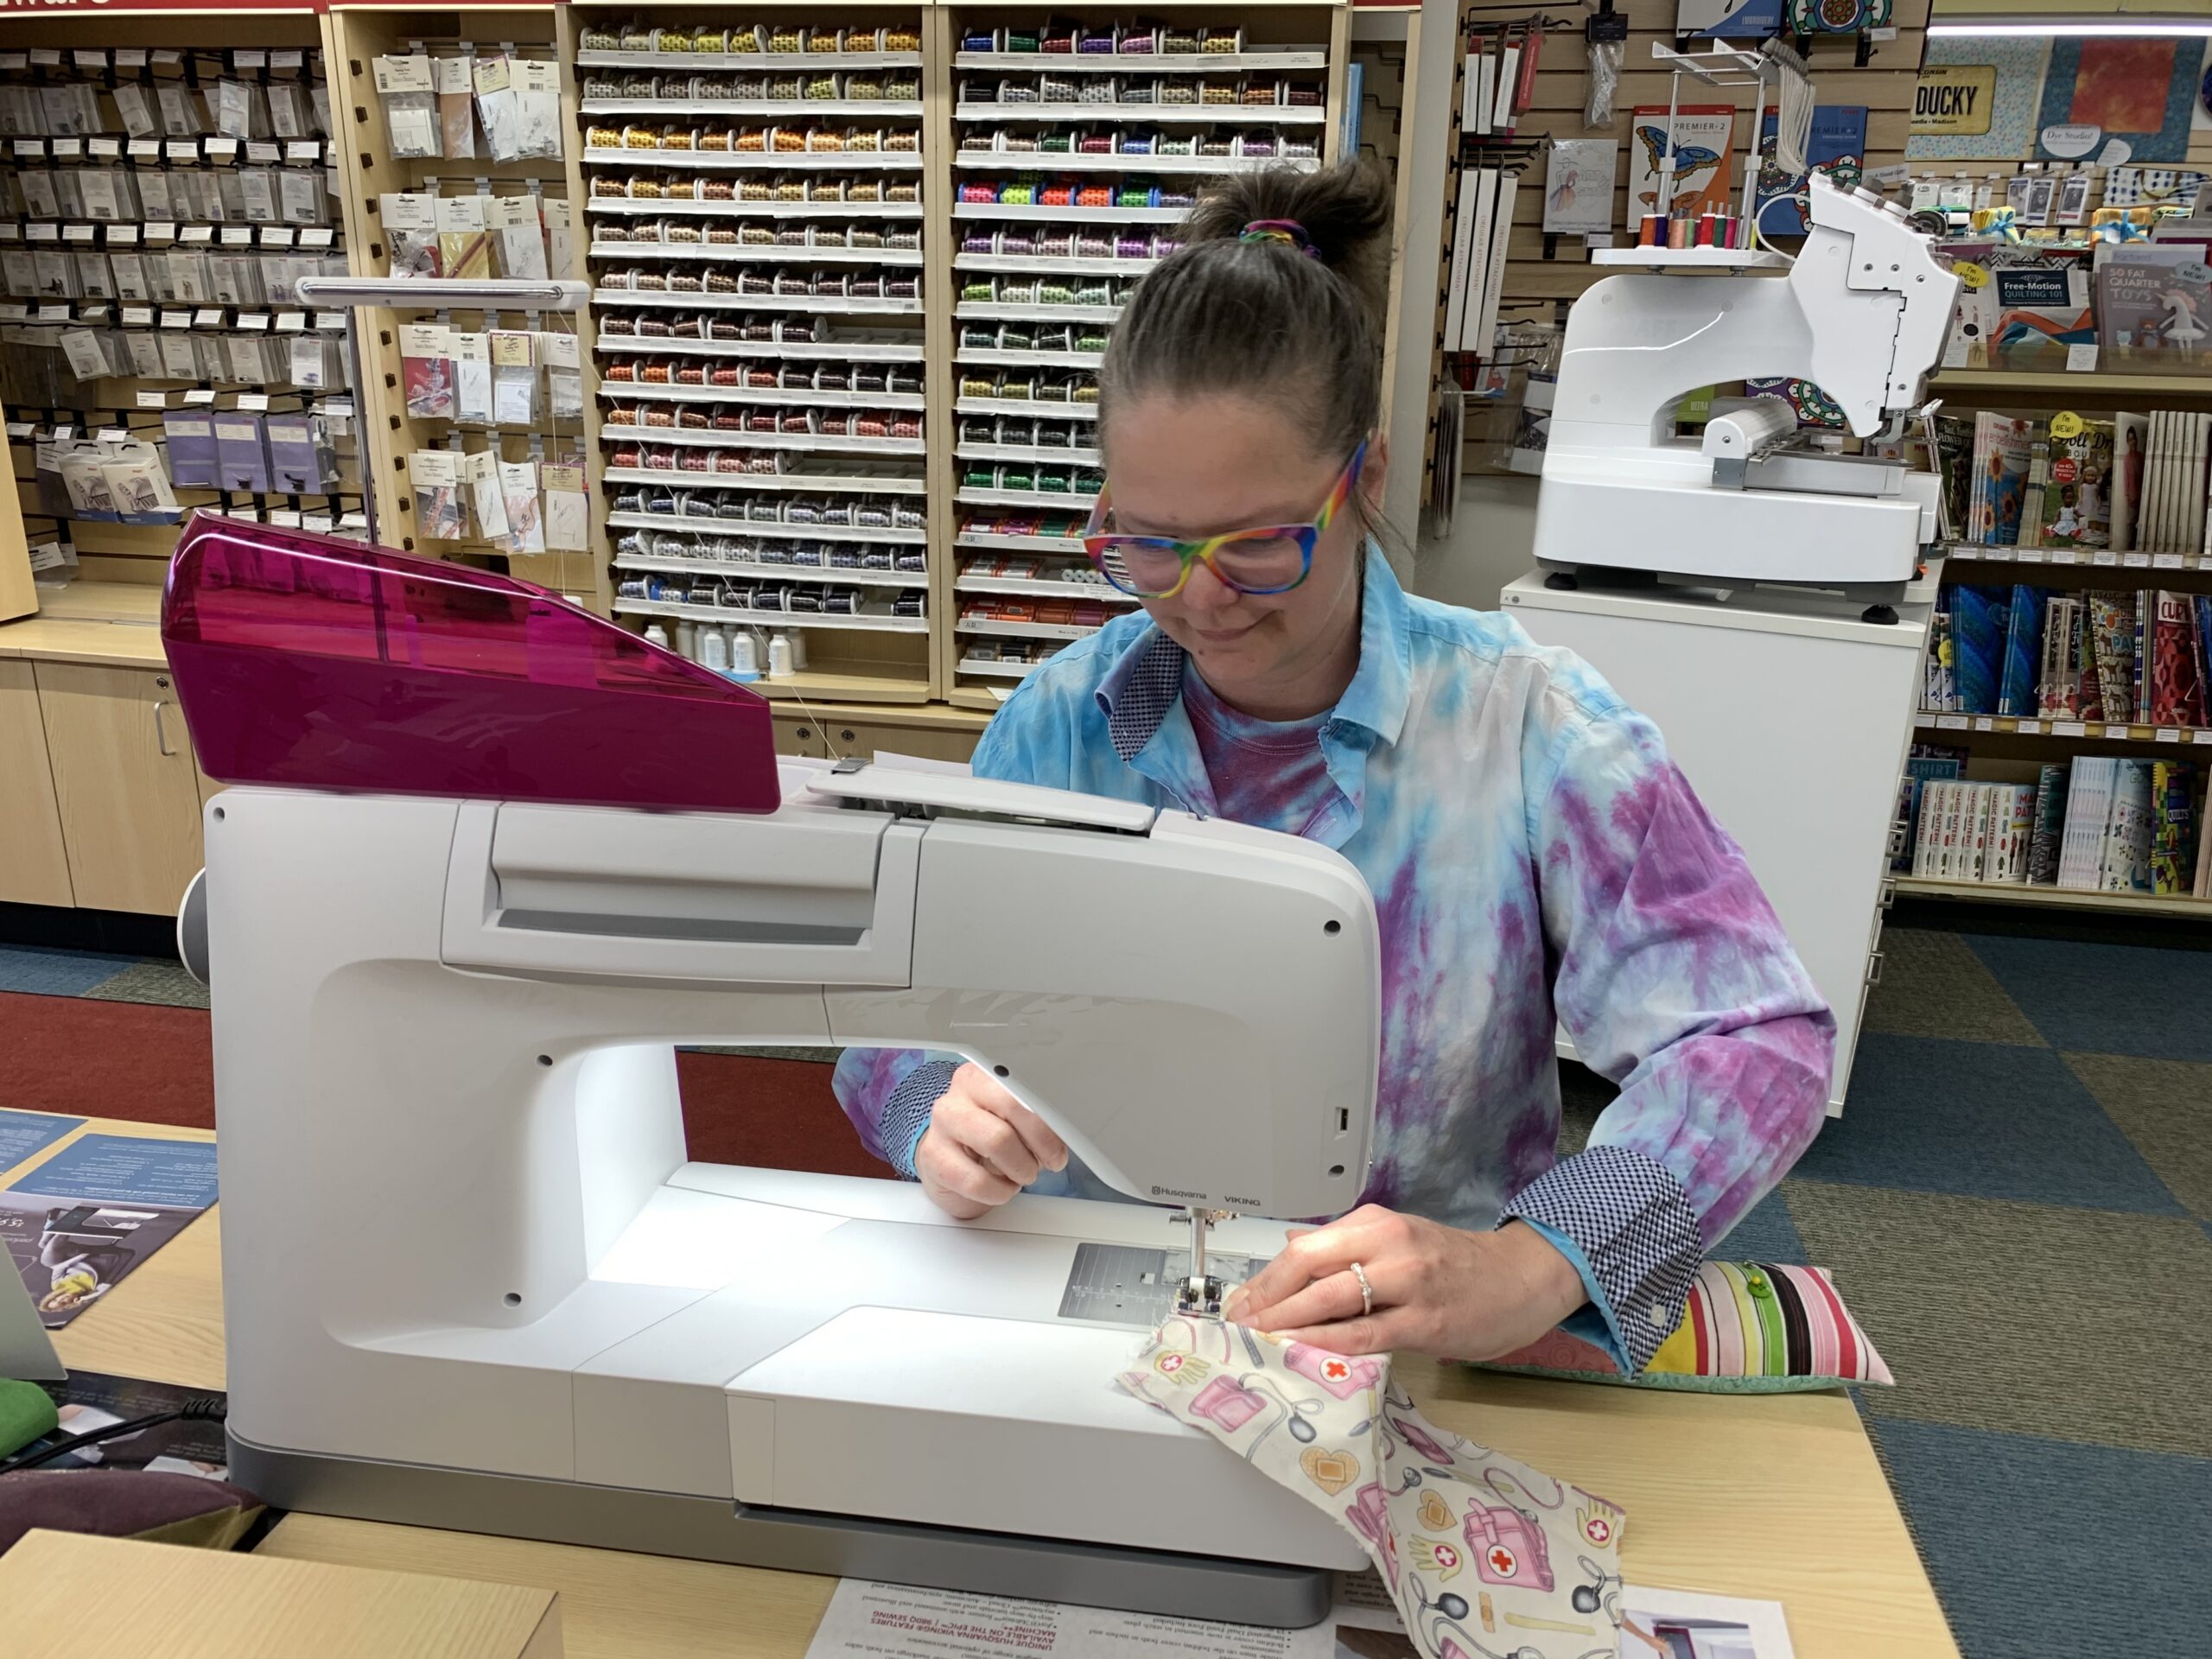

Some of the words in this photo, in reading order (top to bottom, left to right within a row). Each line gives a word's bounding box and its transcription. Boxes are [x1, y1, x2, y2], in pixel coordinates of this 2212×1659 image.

[1916, 86, 1978, 115] DUCKY
[2047, 130, 2063, 140] Dye
[2109, 268, 2126, 276] 50
[2127, 269, 2145, 278] FAT
[2004, 282, 2062, 290] Free-Motion
[2109, 277, 2162, 289] QUARTER
[2110, 288, 2152, 301] TOYS
[2055, 424, 2075, 434] NEW!
[1910, 762, 1951, 776] SHIRT
[1917, 812, 1928, 843] PATTERN
[1933, 814, 1942, 843] PATTERN
[1950, 815, 1960, 843] PATTERN
[1965, 816, 1974, 845] PATTERN
[1987, 816, 1996, 846] PATTERN
[1161, 1186, 1207, 1200] Husqvarna
[1224, 1195, 1262, 1207] VIKING
[898, 1600, 913, 1609] and
[872, 1611, 908, 1623] SEWING
[870, 1618, 914, 1630] FEATURES
[969, 1625, 988, 1634] THE
[957, 1631, 1014, 1646] HUSQVARNA
[1007, 1631, 1055, 1643] AVAILABLE
[1014, 1641, 1052, 1651] UNIQUE
